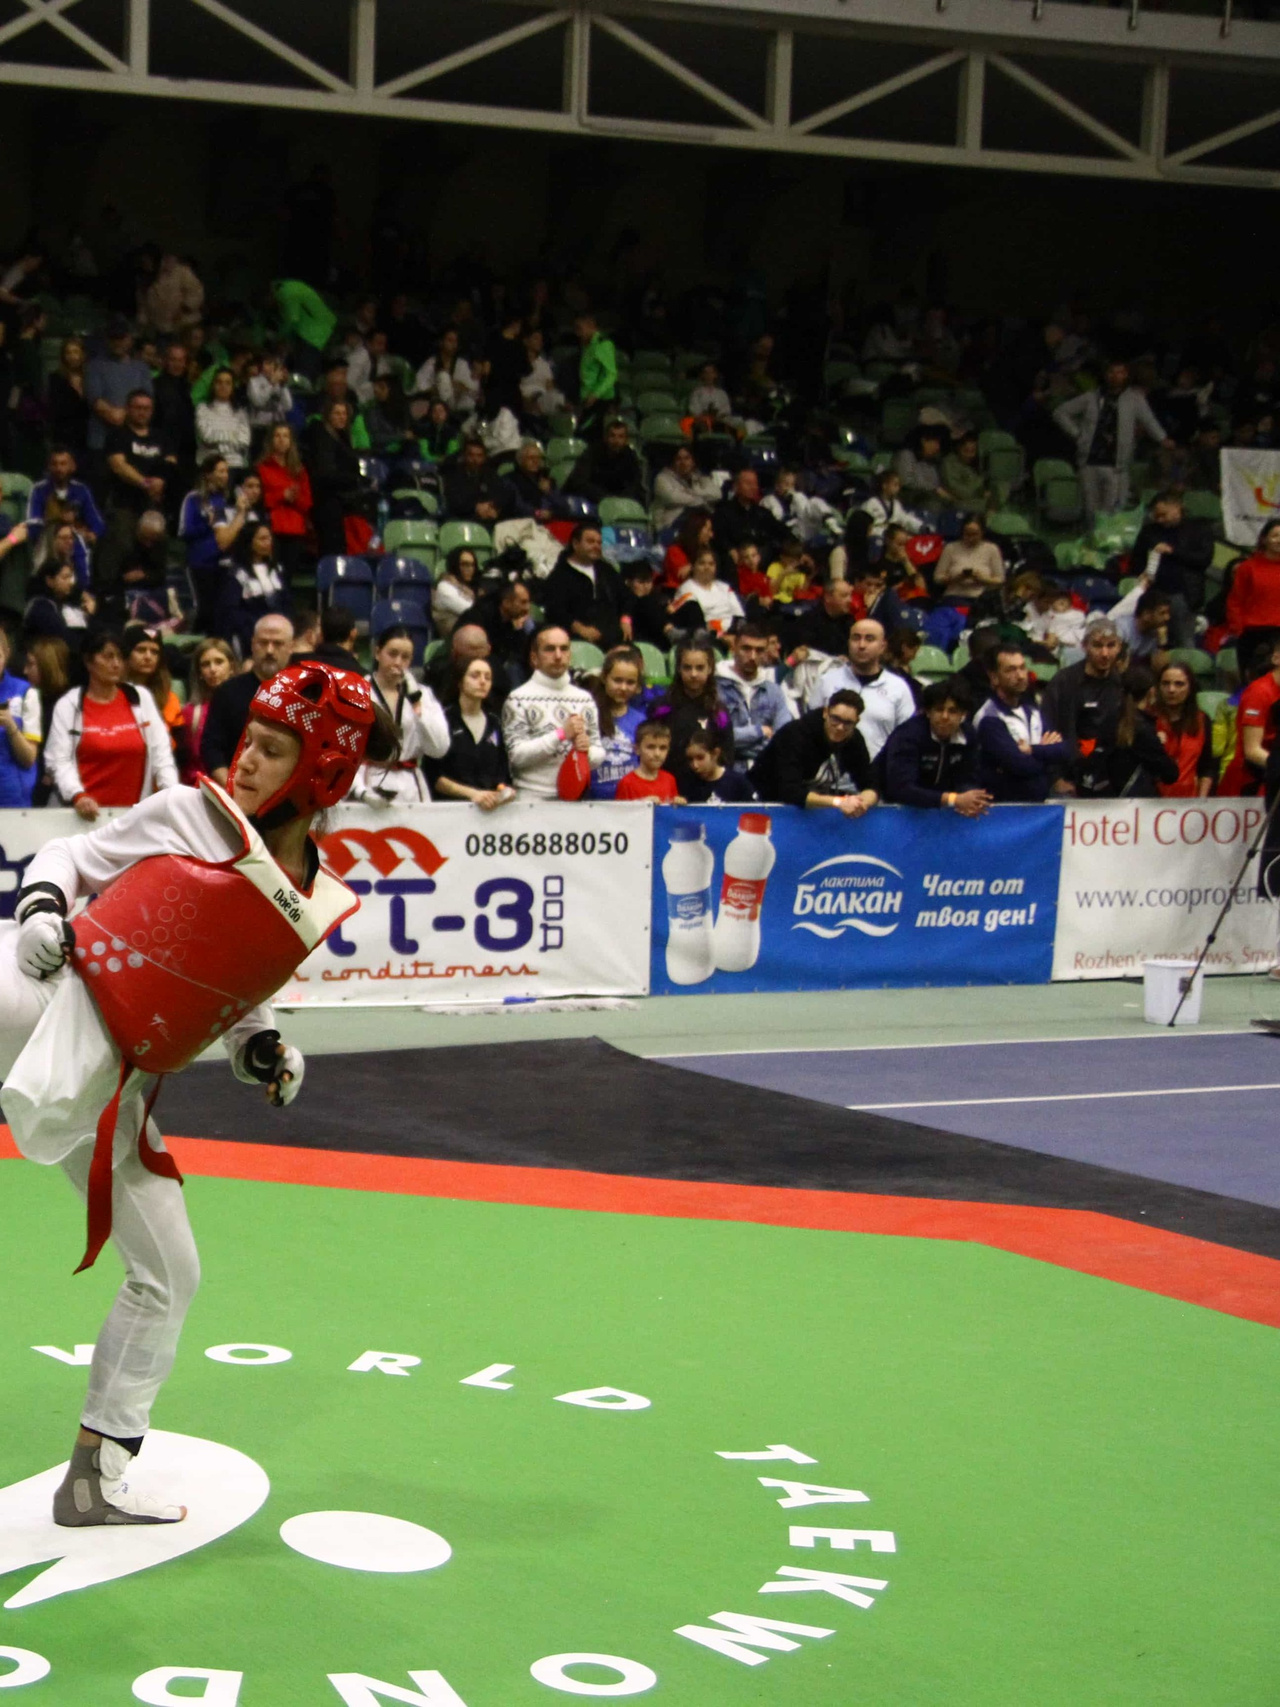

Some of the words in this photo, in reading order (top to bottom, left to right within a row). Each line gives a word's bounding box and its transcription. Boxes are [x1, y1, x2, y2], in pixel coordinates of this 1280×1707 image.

[1153, 808, 1261, 845] COOP
[465, 831, 629, 857] 0886888050
[820, 876, 885, 888] лактима
[923, 874, 986, 896] Част
[989, 878, 1025, 895] от
[793, 883, 903, 915] Балкан
[915, 906, 980, 928] твоя
[984, 902, 1037, 932] ден!
[322, 960, 539, 982] conditioners
